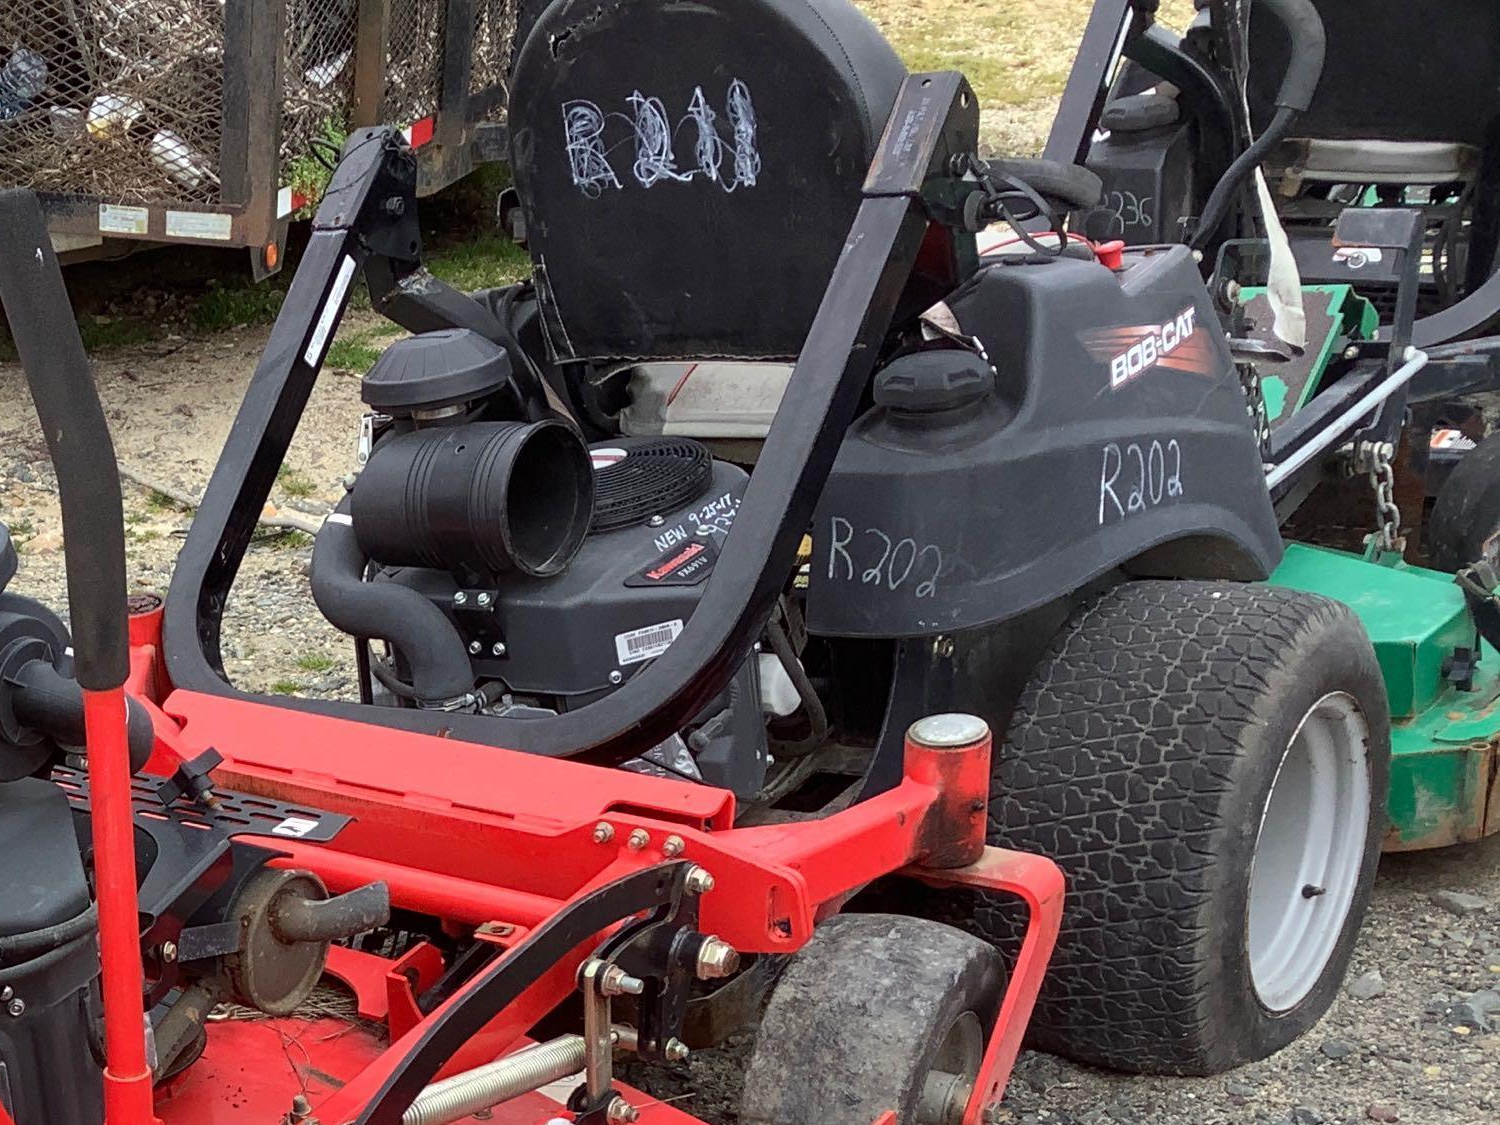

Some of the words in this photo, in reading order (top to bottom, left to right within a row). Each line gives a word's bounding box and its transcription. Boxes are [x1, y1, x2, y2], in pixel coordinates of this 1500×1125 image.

[1110, 304, 1196, 389] BOB-CAT
[1099, 438, 1184, 525] R202
[653, 524, 688, 552] NEW
[828, 516, 943, 599] R202
